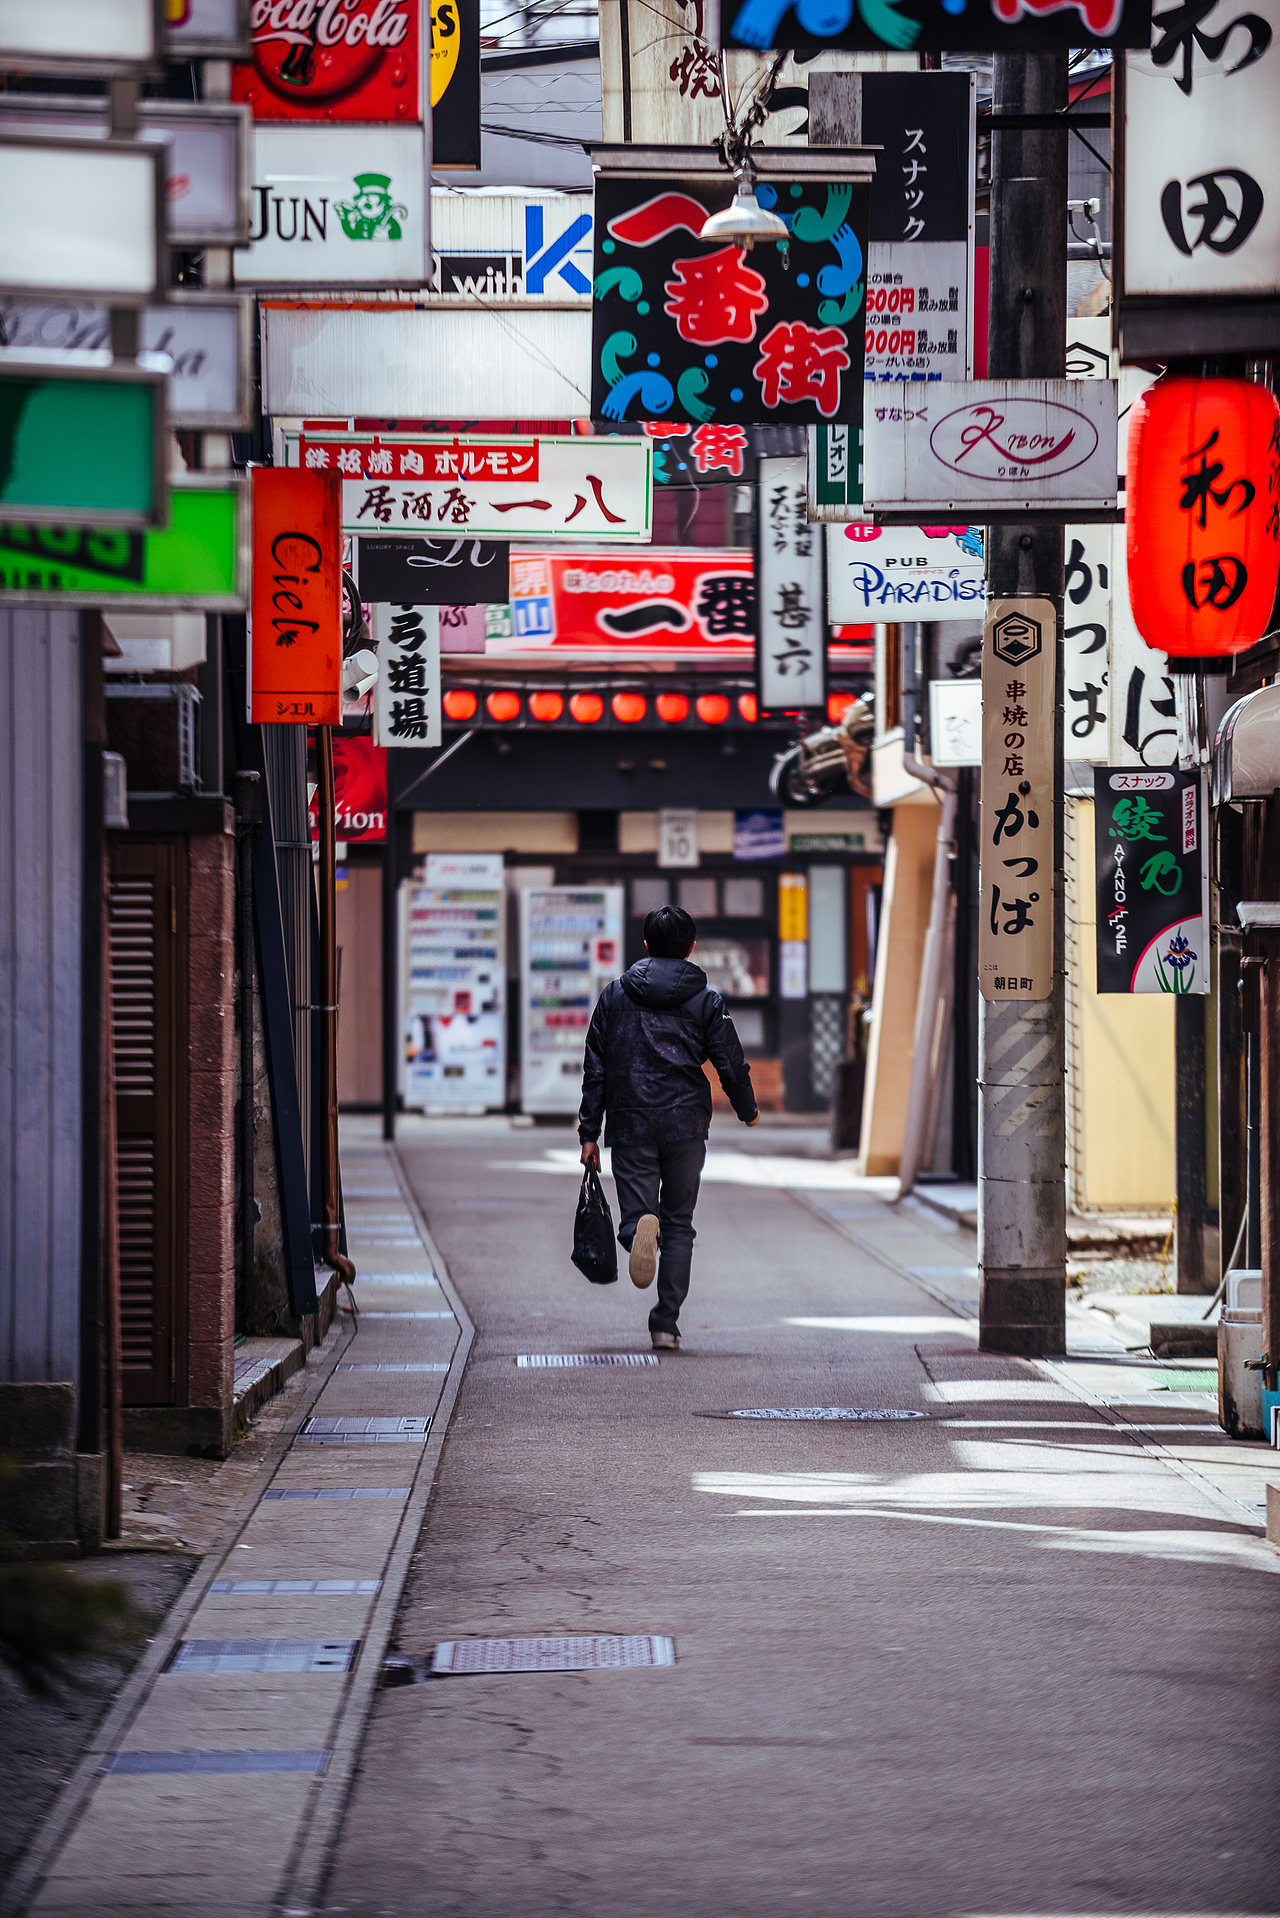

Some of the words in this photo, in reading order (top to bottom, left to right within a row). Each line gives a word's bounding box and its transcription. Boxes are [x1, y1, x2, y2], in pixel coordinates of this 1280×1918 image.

[902, 128, 927, 243] スナック
[606, 191, 852, 418] 一番街
[918, 299, 958, 312] 飲み放題
[917, 341, 957, 354] 飲み放題
[874, 406, 928, 422] すなっく
[434, 450, 535, 476] ホルモン
[356, 485, 477, 524] 居酒屋
[1179, 427, 1256, 611] 和田
[853, 526, 874, 538] 1F
[885, 557, 928, 567] PUB
[276, 702, 315, 716] シエル
[1002, 680, 1029, 776] 串焼の店
[1117, 775, 1167, 788] スナック
[1185, 791, 1195, 849] カラオケ無料
[1109, 796, 1183, 896] 綾乃
[991, 792, 1040, 935] かっぱ
[1114, 844, 1126, 903] AYANO
[1115, 925, 1127, 955] 2F
[994, 977, 1033, 991] 朝日町
